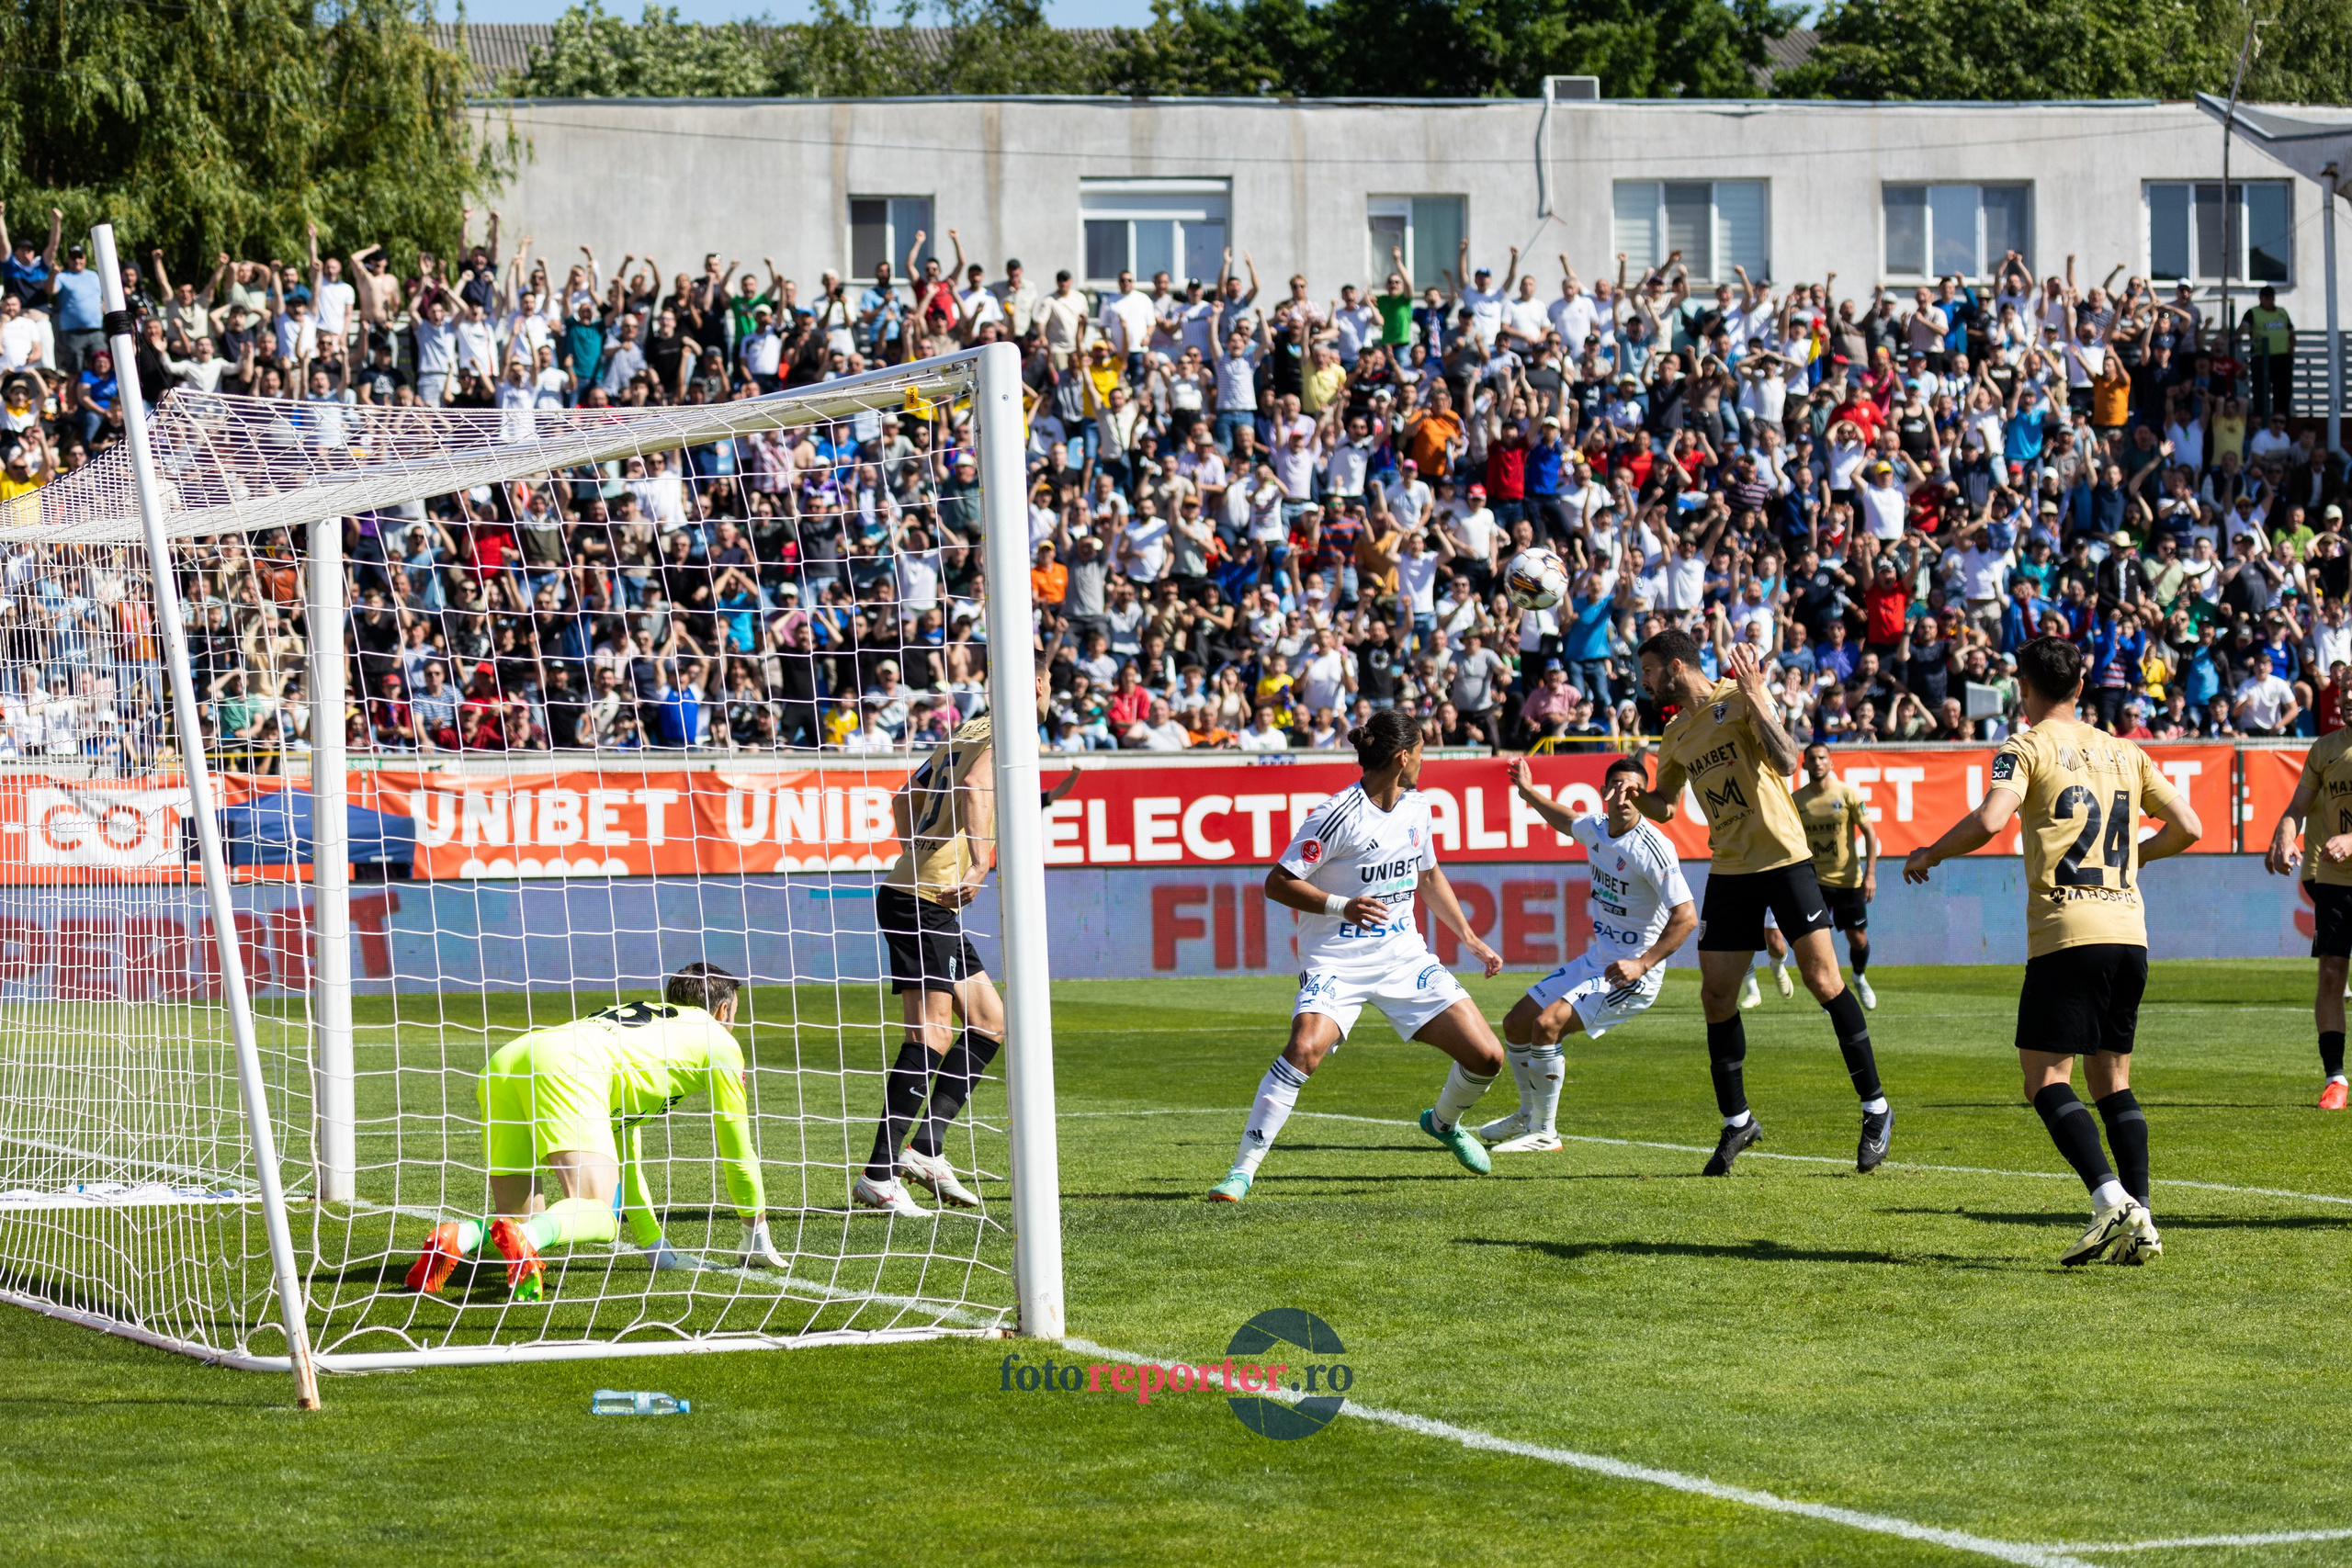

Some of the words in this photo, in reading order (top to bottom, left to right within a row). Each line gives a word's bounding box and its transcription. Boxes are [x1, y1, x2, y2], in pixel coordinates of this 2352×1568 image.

[1687, 741, 1738, 780] MAXBET
[409, 786, 679, 848] UNIBET
[726, 785, 896, 846] UNIB
[2054, 785, 2131, 890] 24
[1361, 855, 1422, 884] UNIBET
[1150, 883, 1268, 971] FII
[1305, 974, 1338, 1000] 44
